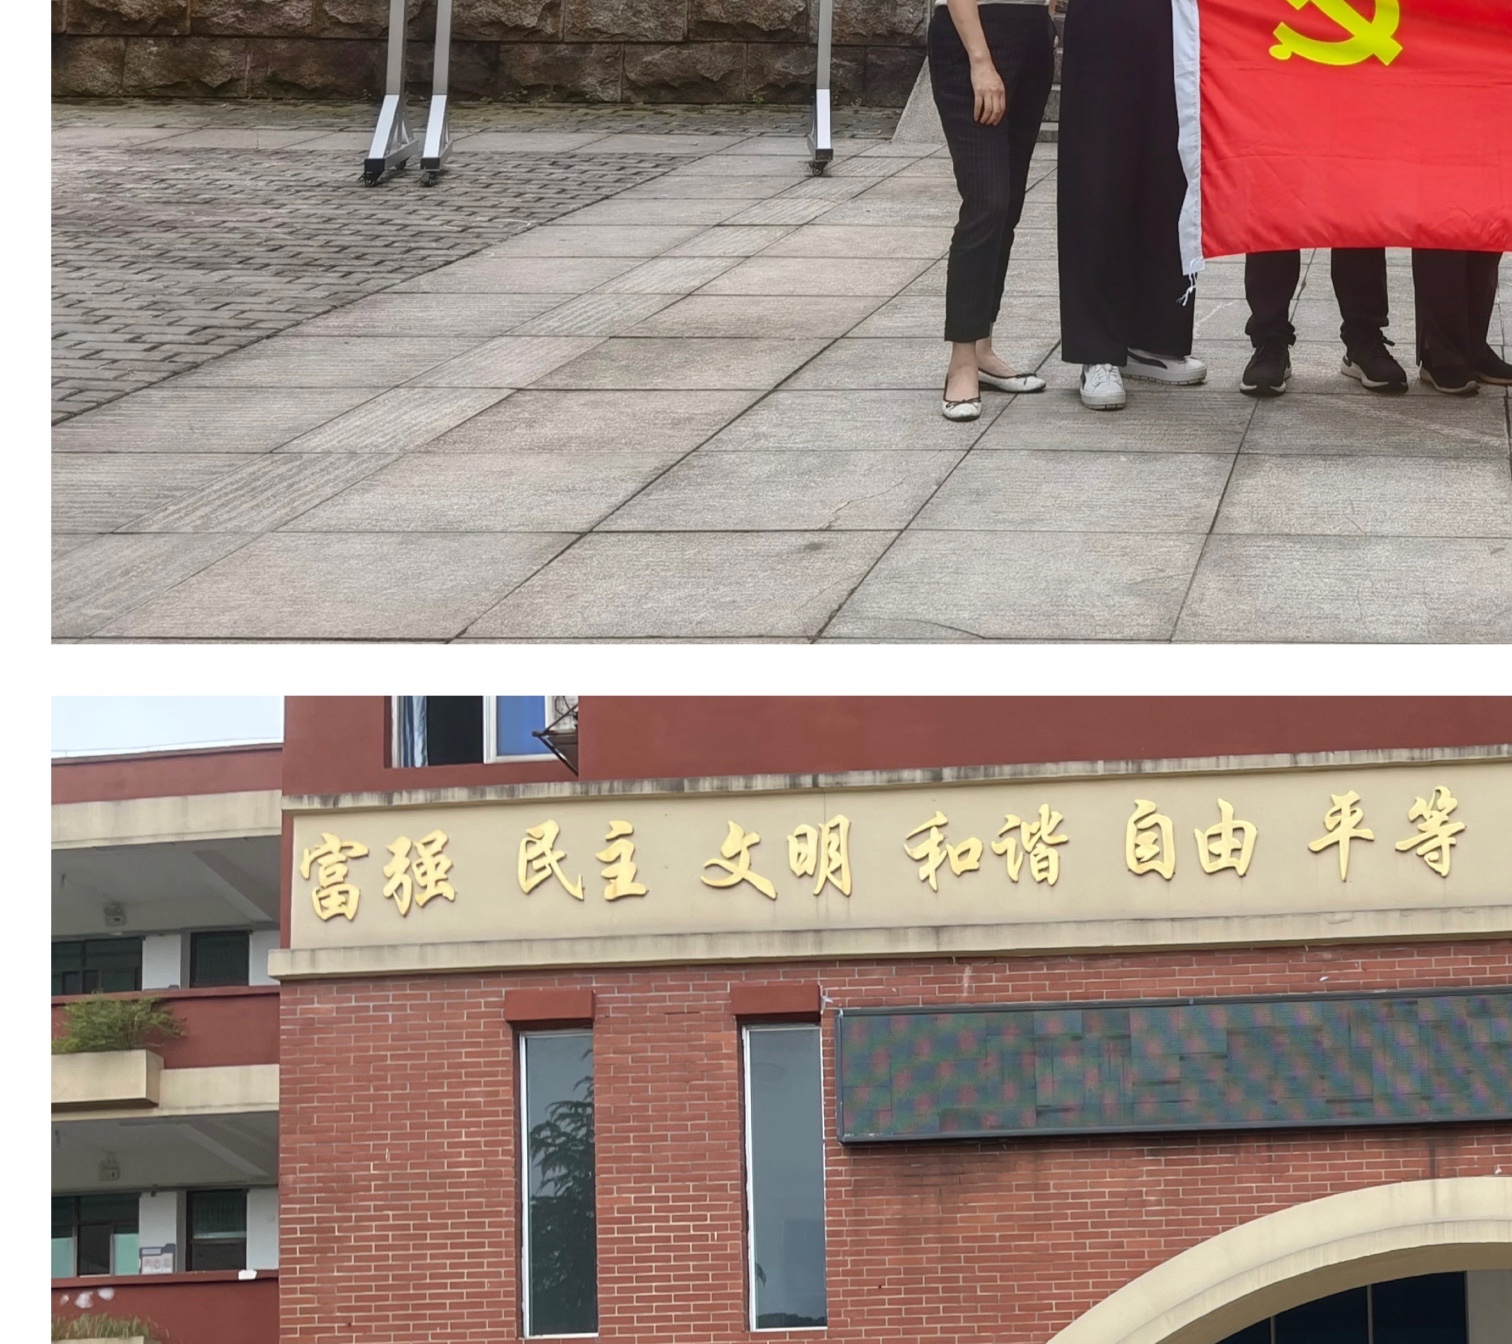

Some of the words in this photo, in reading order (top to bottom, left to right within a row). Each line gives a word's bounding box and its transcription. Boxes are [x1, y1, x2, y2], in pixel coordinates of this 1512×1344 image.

[299, 829, 455, 919] 富强
[517, 817, 650, 901] 民主
[700, 813, 853, 899] 文明
[904, 803, 1069, 892] 和谐
[1123, 798, 1260, 882] 自由
[1307, 784, 1466, 883] 平等
